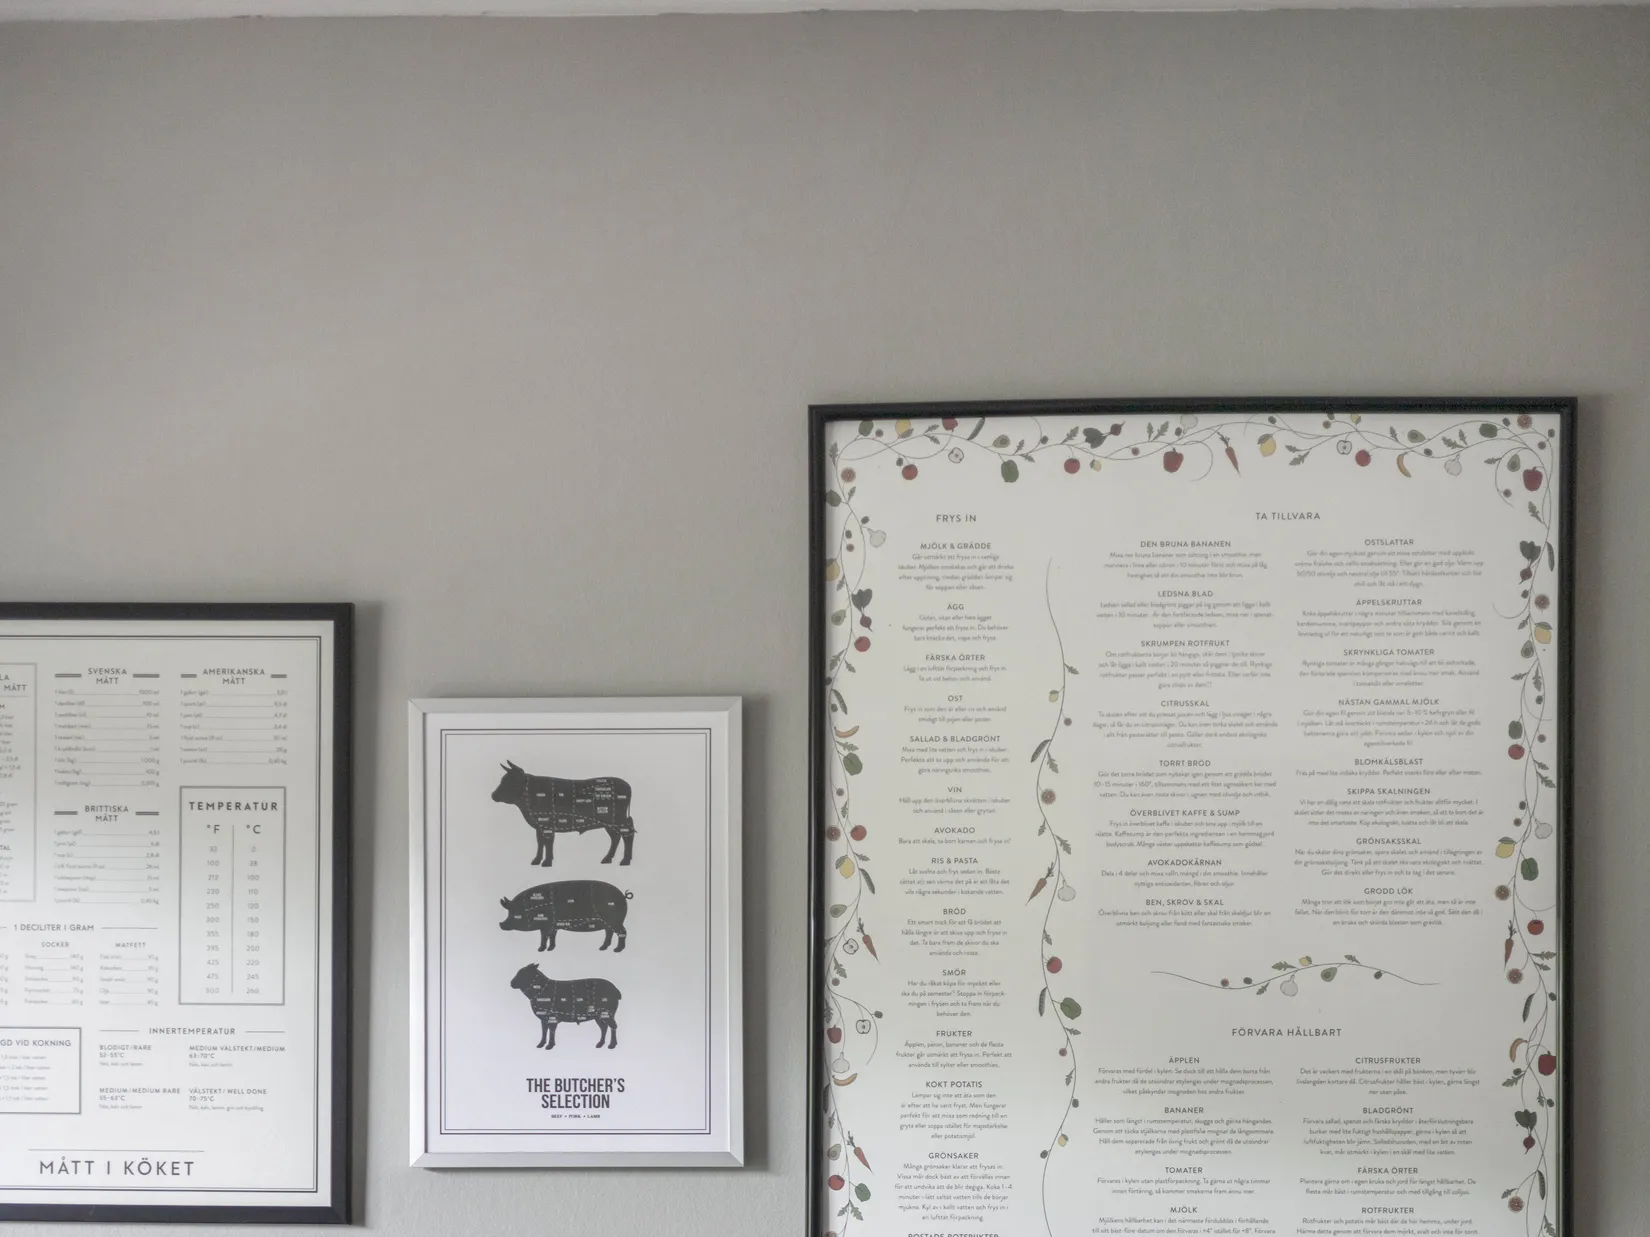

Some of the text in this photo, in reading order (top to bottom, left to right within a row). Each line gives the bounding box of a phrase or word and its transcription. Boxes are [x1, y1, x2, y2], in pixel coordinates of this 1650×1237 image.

[936, 514, 976, 523] FRYS IN
[1255, 512, 1321, 520] TA TILLVARA
[920, 542, 947, 550] MJÖLK
[1159, 540, 1189, 548] BRUNA
[1190, 540, 1231, 548] BANANEN
[1158, 590, 1214, 598] LEDSNA BLAD
[1396, 648, 1435, 656] TOMATER
[925, 653, 986, 661] FÄRSKA ÖRTER
[88, 667, 127, 677] SVENSKA
[202, 668, 265, 677] AMERIKANSKA
[96, 676, 119, 684] MÅTT
[222, 676, 246, 685] MÅTT
[4, 683, 27, 691] MÅTT
[1373, 698, 1410, 706] GAMMAL
[909, 735, 941, 743] SALLAD
[1377, 787, 1431, 795] SKALNINGEN
[84, 805, 129, 814] BRITTISKA
[189, 801, 278, 811] TEMPERATUR
[1129, 809, 1180, 817] ÖVERBLIVET
[1182, 809, 1207, 817] KAFFE
[1217, 809, 1240, 817] SUMP
[95, 813, 118, 822] MÅTT
[1147, 857, 1222, 866] AVOKADOKÄRNAN
[1364, 887, 1413, 895] GRODD LÖK
[1145, 899, 1165, 907] BEN,
[943, 907, 967, 915] BRÖD
[20, 923, 61, 931] DECILITER
[942, 968, 966, 976] SMÖR
[149, 1027, 235, 1035] INNERTEMPERATUR
[1232, 1026, 1342, 1037] FÖRVARA HÅLLBART
[15, 1039, 30, 1047] VID
[32, 1039, 72, 1047] KOKNING
[1168, 1056, 1200, 1064] ÄPPLEN
[526, 1078, 551, 1093] THE
[926, 1080, 948, 1088] KOKT
[541, 1094, 610, 1109] SELECTION
[1164, 1106, 1204, 1114] BANANER
[1362, 1106, 1414, 1114] BLADGRÖNT
[40, 1156, 194, 1176] MÅTT I KÖKET
[1165, 1166, 1203, 1174] TOMATER
[1357, 1166, 1418, 1174] FÄRSKA ÖRTER
[1170, 1205, 1198, 1213] MJÖLK
